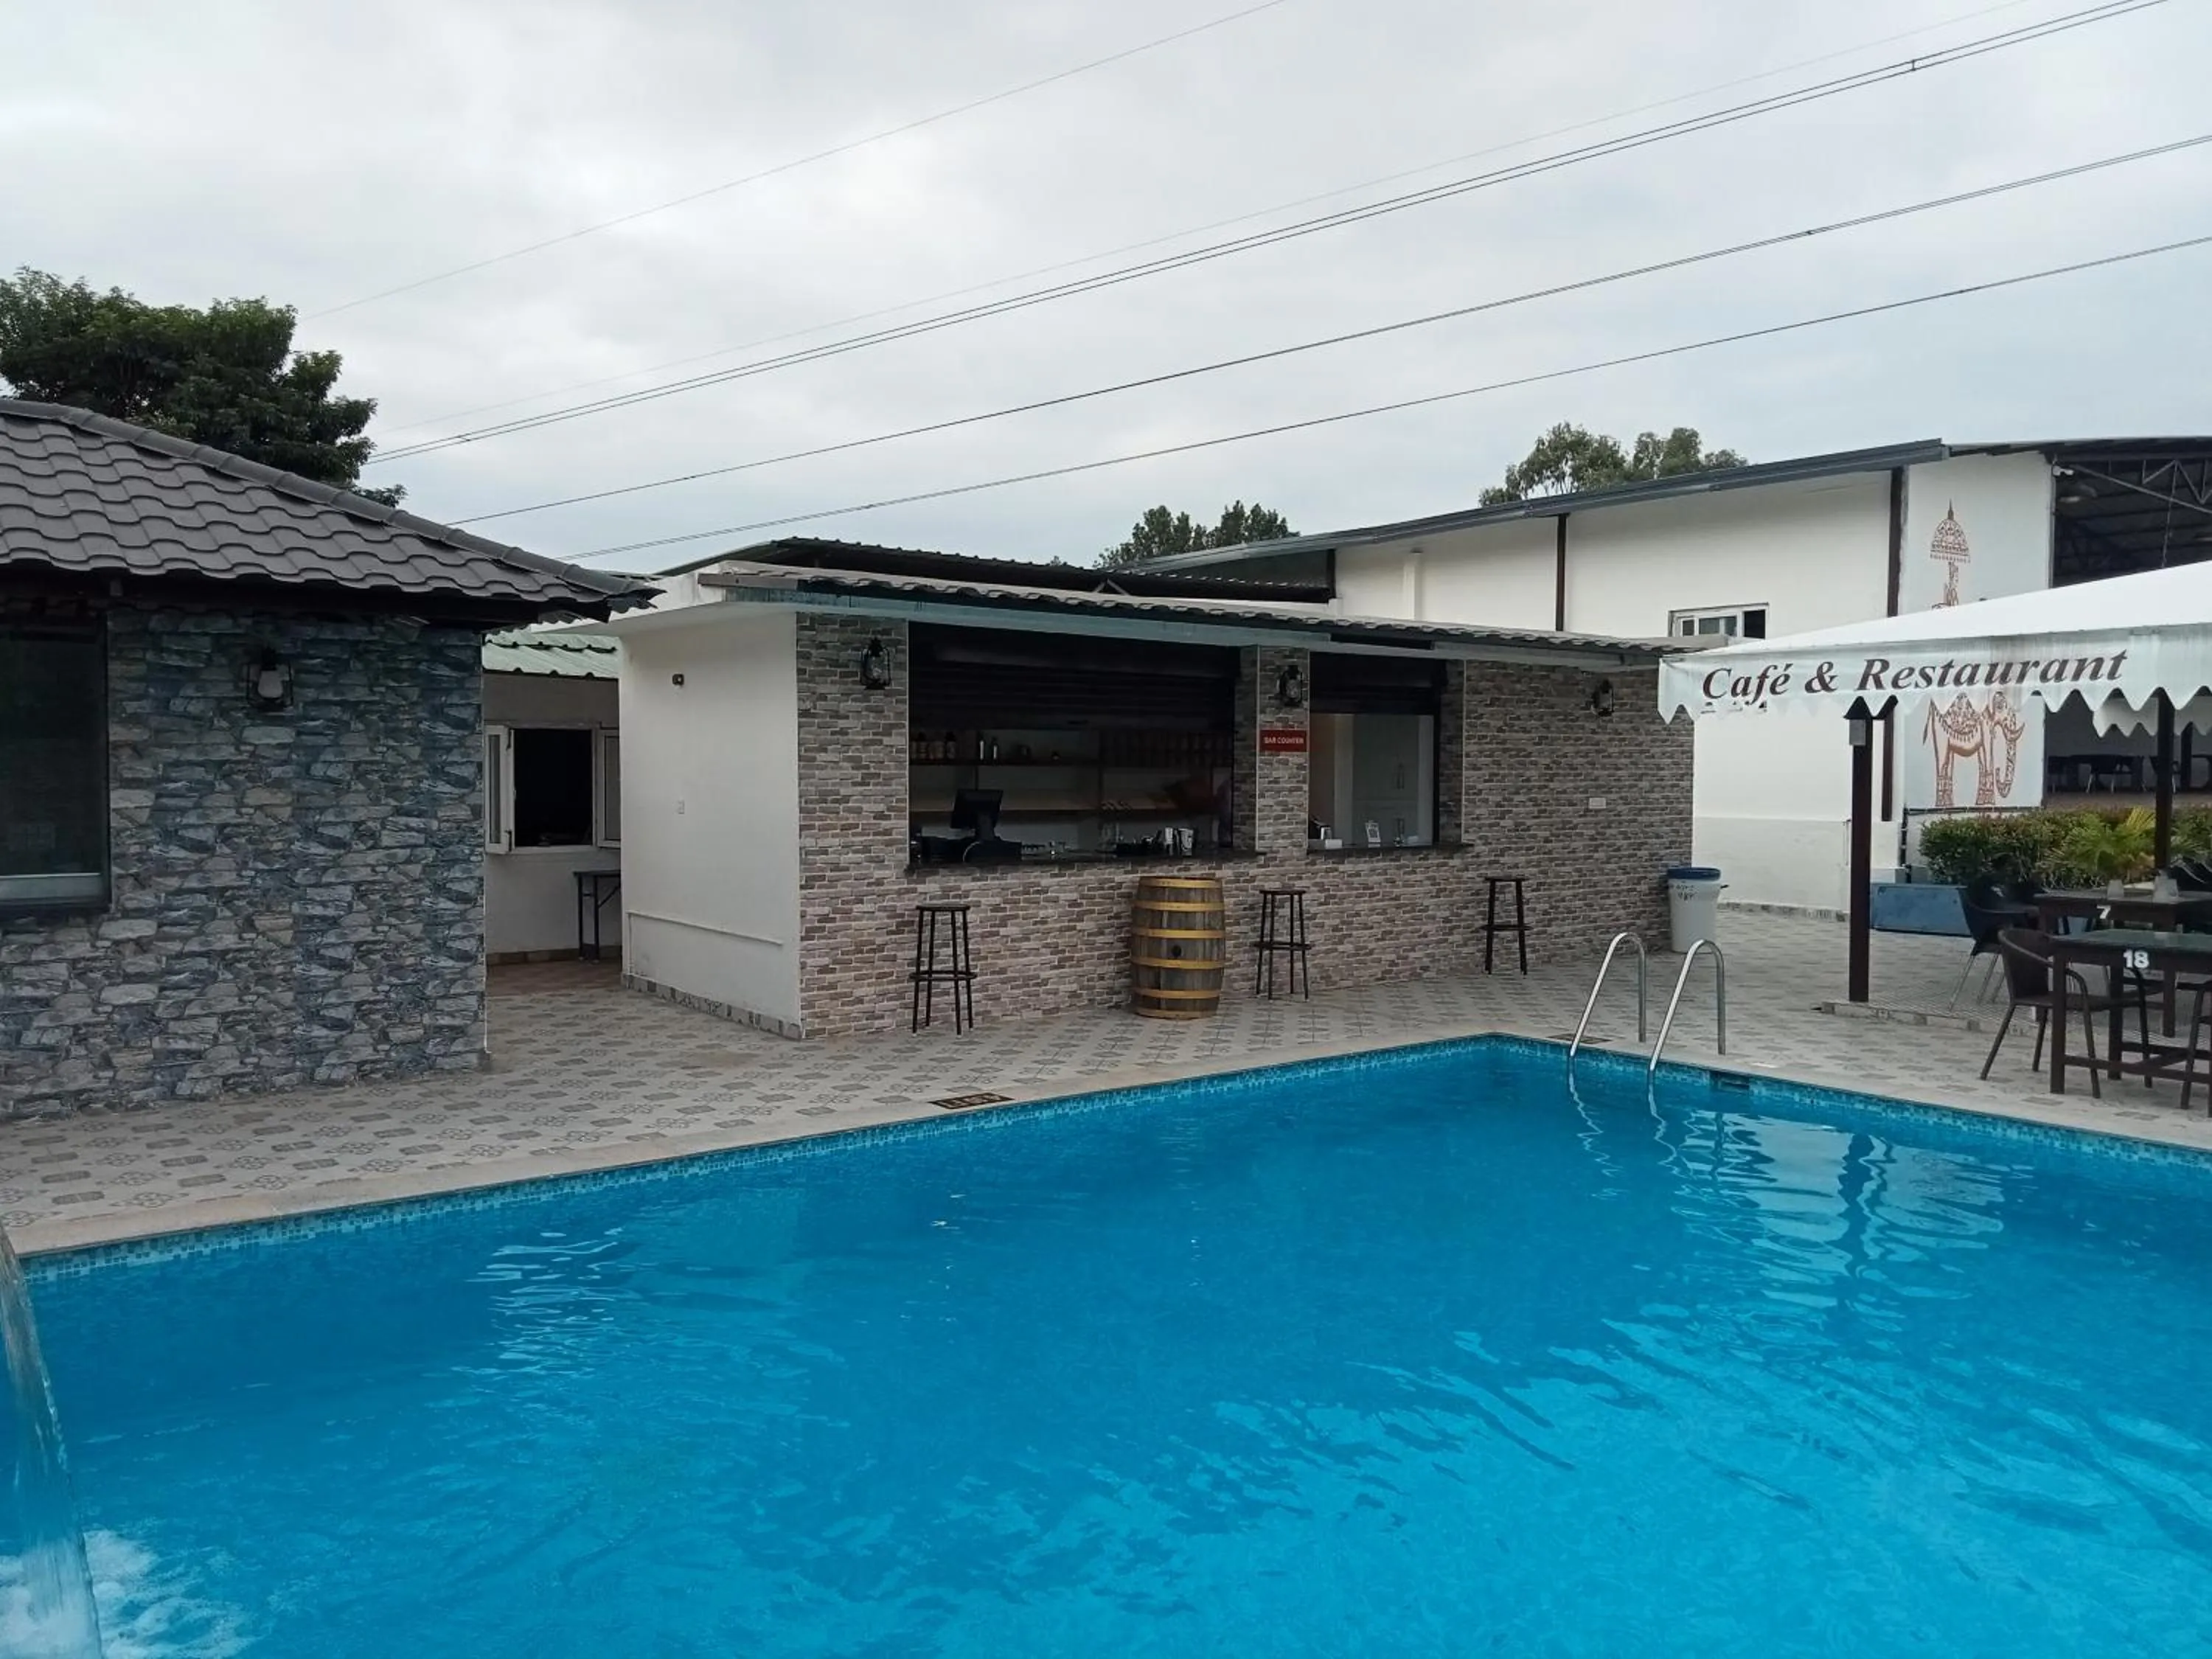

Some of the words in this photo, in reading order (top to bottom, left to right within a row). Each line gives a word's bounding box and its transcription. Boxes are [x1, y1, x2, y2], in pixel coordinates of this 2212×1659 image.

[1702, 663, 1794, 706] Café
[1804, 661, 1838, 694] &
[1854, 648, 2128, 691] Restaurant
[2096, 905, 2111, 919] 7
[2123, 949, 2150, 969] 18
